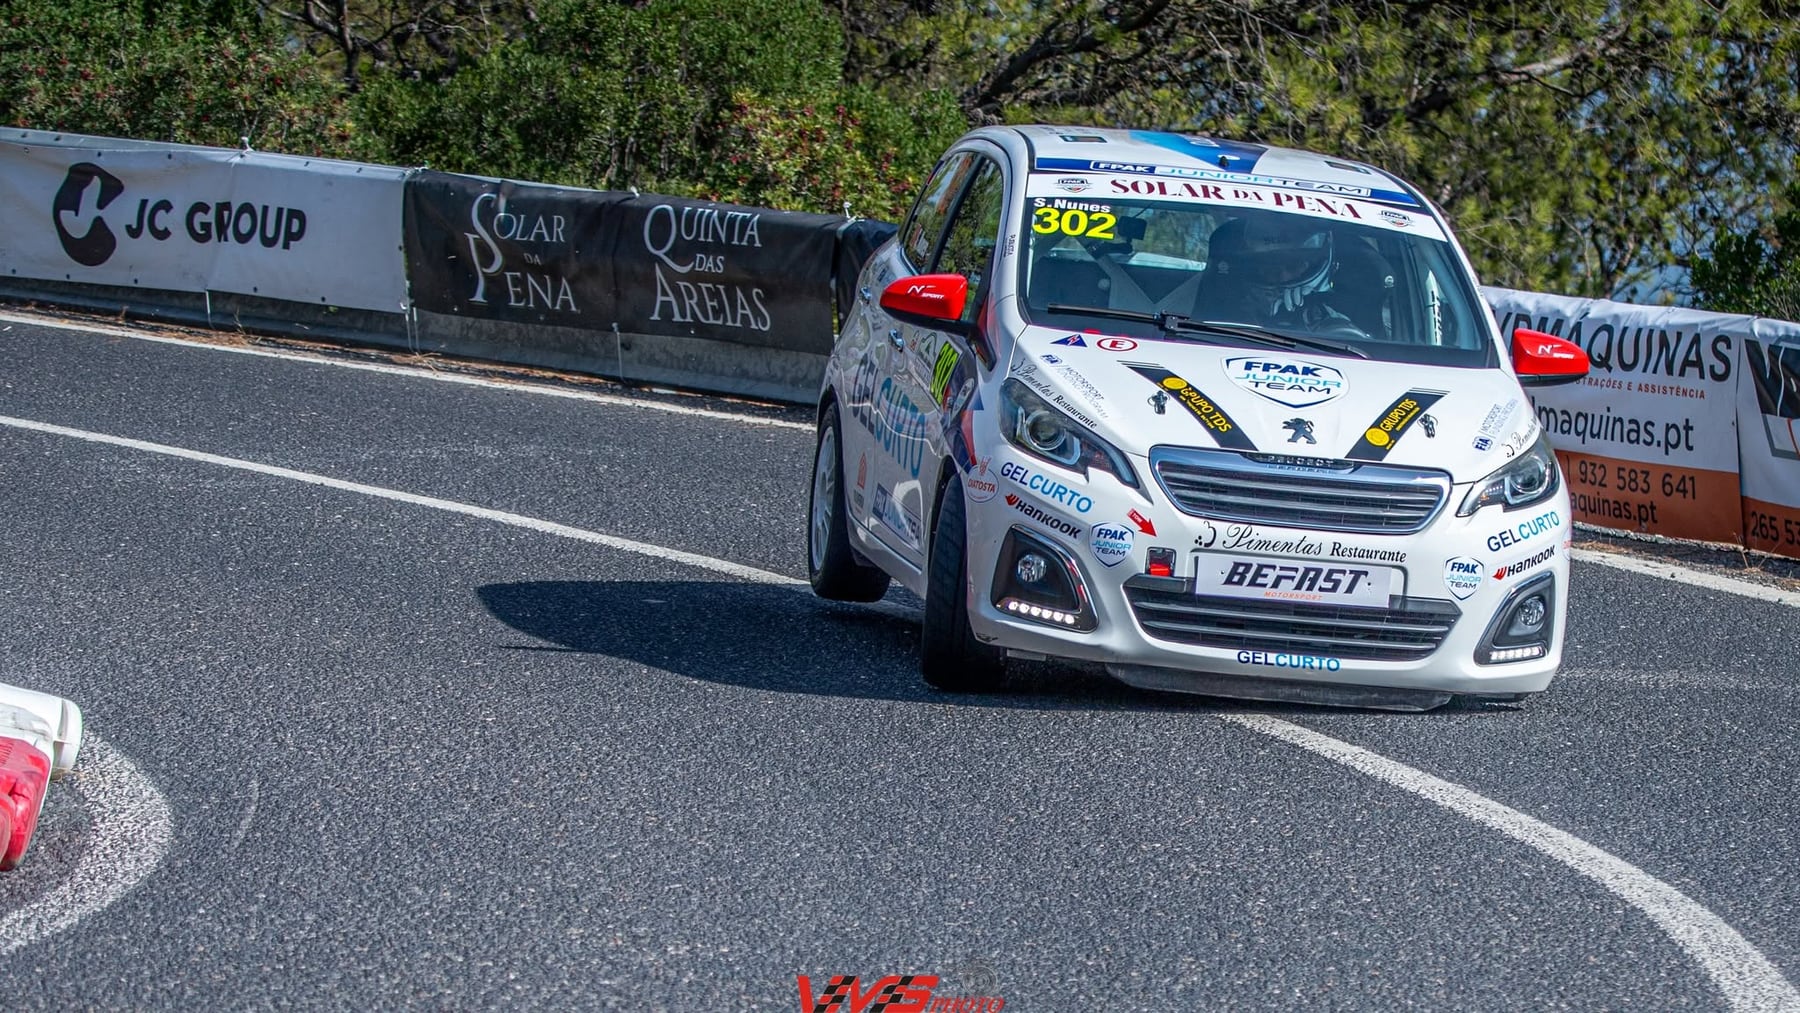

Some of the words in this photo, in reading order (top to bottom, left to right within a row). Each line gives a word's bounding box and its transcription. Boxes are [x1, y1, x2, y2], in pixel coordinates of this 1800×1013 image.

[1098, 162, 1150, 174] FPAK
[1033, 197, 1111, 214] S.Nunes
[1110, 178, 1226, 201] SOLAR
[1272, 191, 1363, 220] PENA
[125, 199, 174, 241] JC
[185, 200, 307, 251] GROUP
[1032, 207, 1118, 241] 302
[643, 203, 764, 273] QUINTA
[693, 252, 726, 274] DAS
[648, 262, 772, 332] AREIAS
[1234, 372, 1342, 389] JUNIOR
[1243, 361, 1324, 378] FPAK
[1248, 380, 1332, 395] TEAM
[1627, 381, 1634, 392] E
[1053, 394, 1098, 430] Restaurante
[1209, 411, 1233, 433] TDS
[1379, 407, 1408, 433] GRUPO
[1000, 462, 1094, 514] GELCURTO
[1578, 459, 1608, 489] 932
[1616, 466, 1651, 495] 583
[1661, 472, 1697, 501] 641
[1096, 528, 1128, 541] FPAK
[1486, 511, 1560, 552] GELCURTO
[1750, 510, 1780, 542] 265
[1091, 539, 1132, 550] JUNIOR
[1095, 547, 1126, 557] TEAM
[1222, 523, 1323, 556] Pimentas
[1329, 541, 1408, 564] Restaurante
[1222, 561, 1369, 594] BEFAST
[1445, 573, 1482, 583] JUNIOR
[1450, 561, 1479, 575] FPAK
[1263, 591, 1324, 601] MOTORSPORT
[1450, 580, 1477, 590] TEAM
[1236, 650, 1342, 673] GELCURTO
